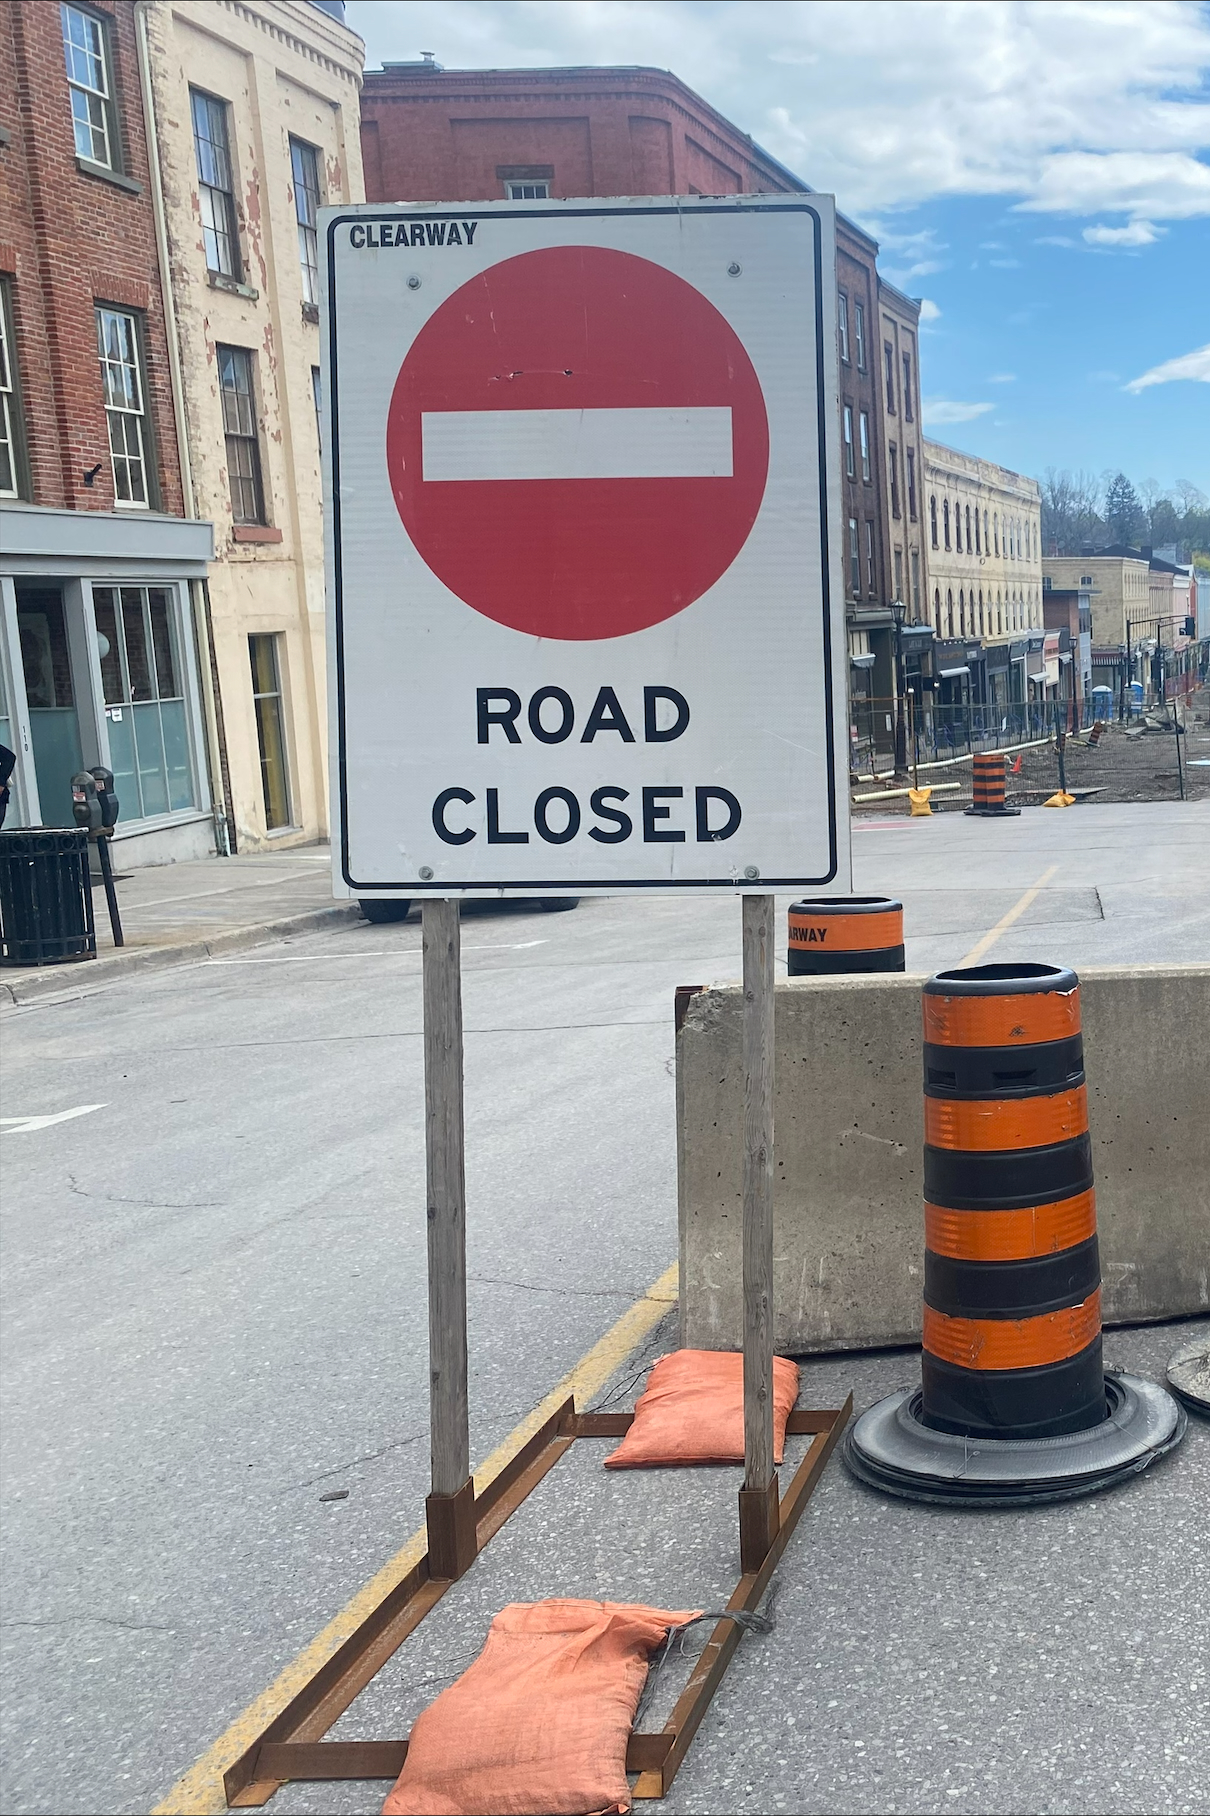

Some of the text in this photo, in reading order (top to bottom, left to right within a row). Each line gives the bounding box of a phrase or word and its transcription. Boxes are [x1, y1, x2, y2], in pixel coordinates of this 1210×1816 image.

[350, 222, 477, 248] CLEARWAY
[476, 686, 690, 744] ROAD
[432, 786, 741, 845] CLOSED
